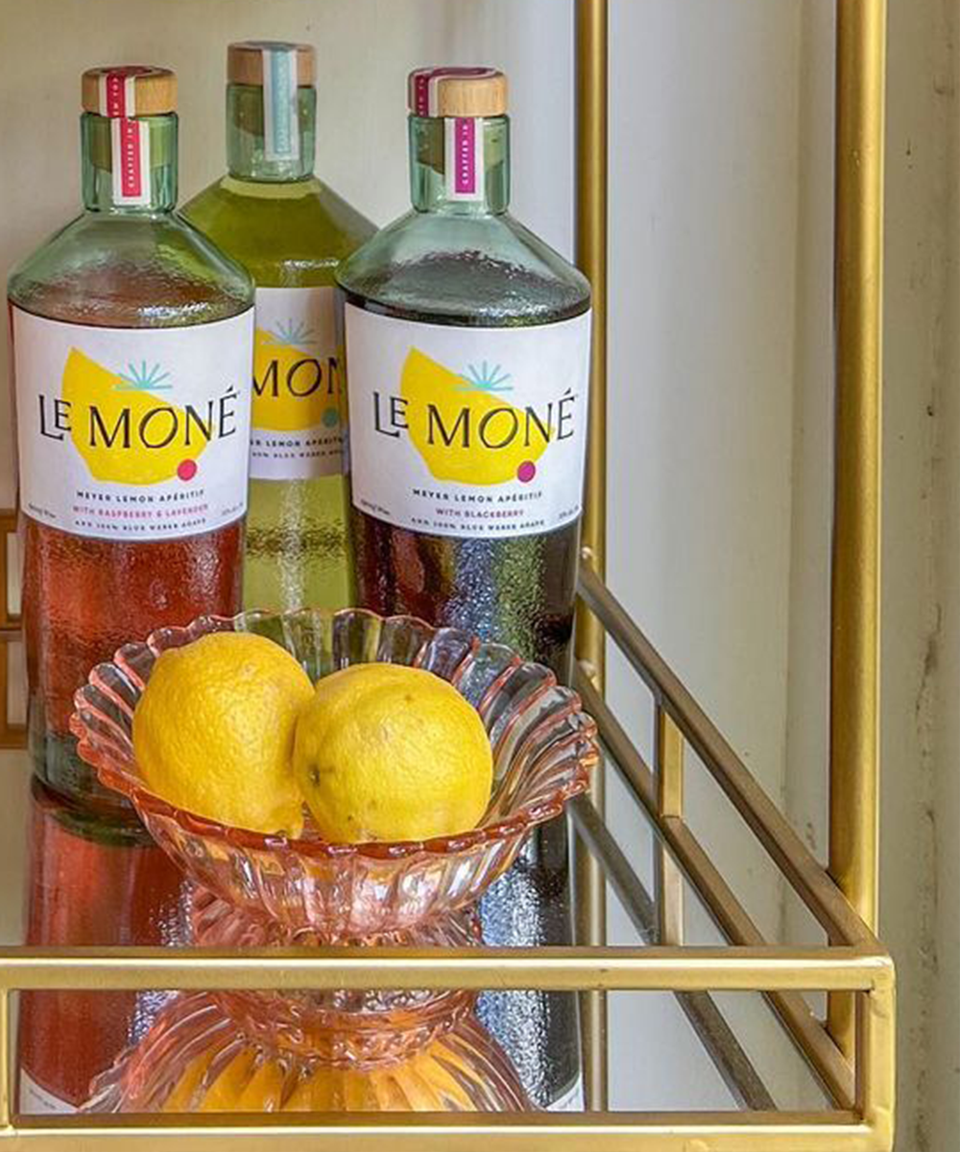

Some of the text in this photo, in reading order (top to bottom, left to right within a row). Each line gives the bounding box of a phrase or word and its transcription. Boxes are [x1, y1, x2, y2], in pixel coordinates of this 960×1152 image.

[38, 386, 238, 449] LE MONÉ
[373, 387, 576, 449] LE MONÉ
[76, 491, 111, 501] MEYER
[115, 494, 154, 504] LEMON
[412, 489, 449, 500] MEYER
[454, 494, 493, 504] LEMON
[73, 505, 95, 515] WITH
[98, 508, 152, 519] RASPBERRY
[435, 508, 524, 519] WITH BLACKBERRY
